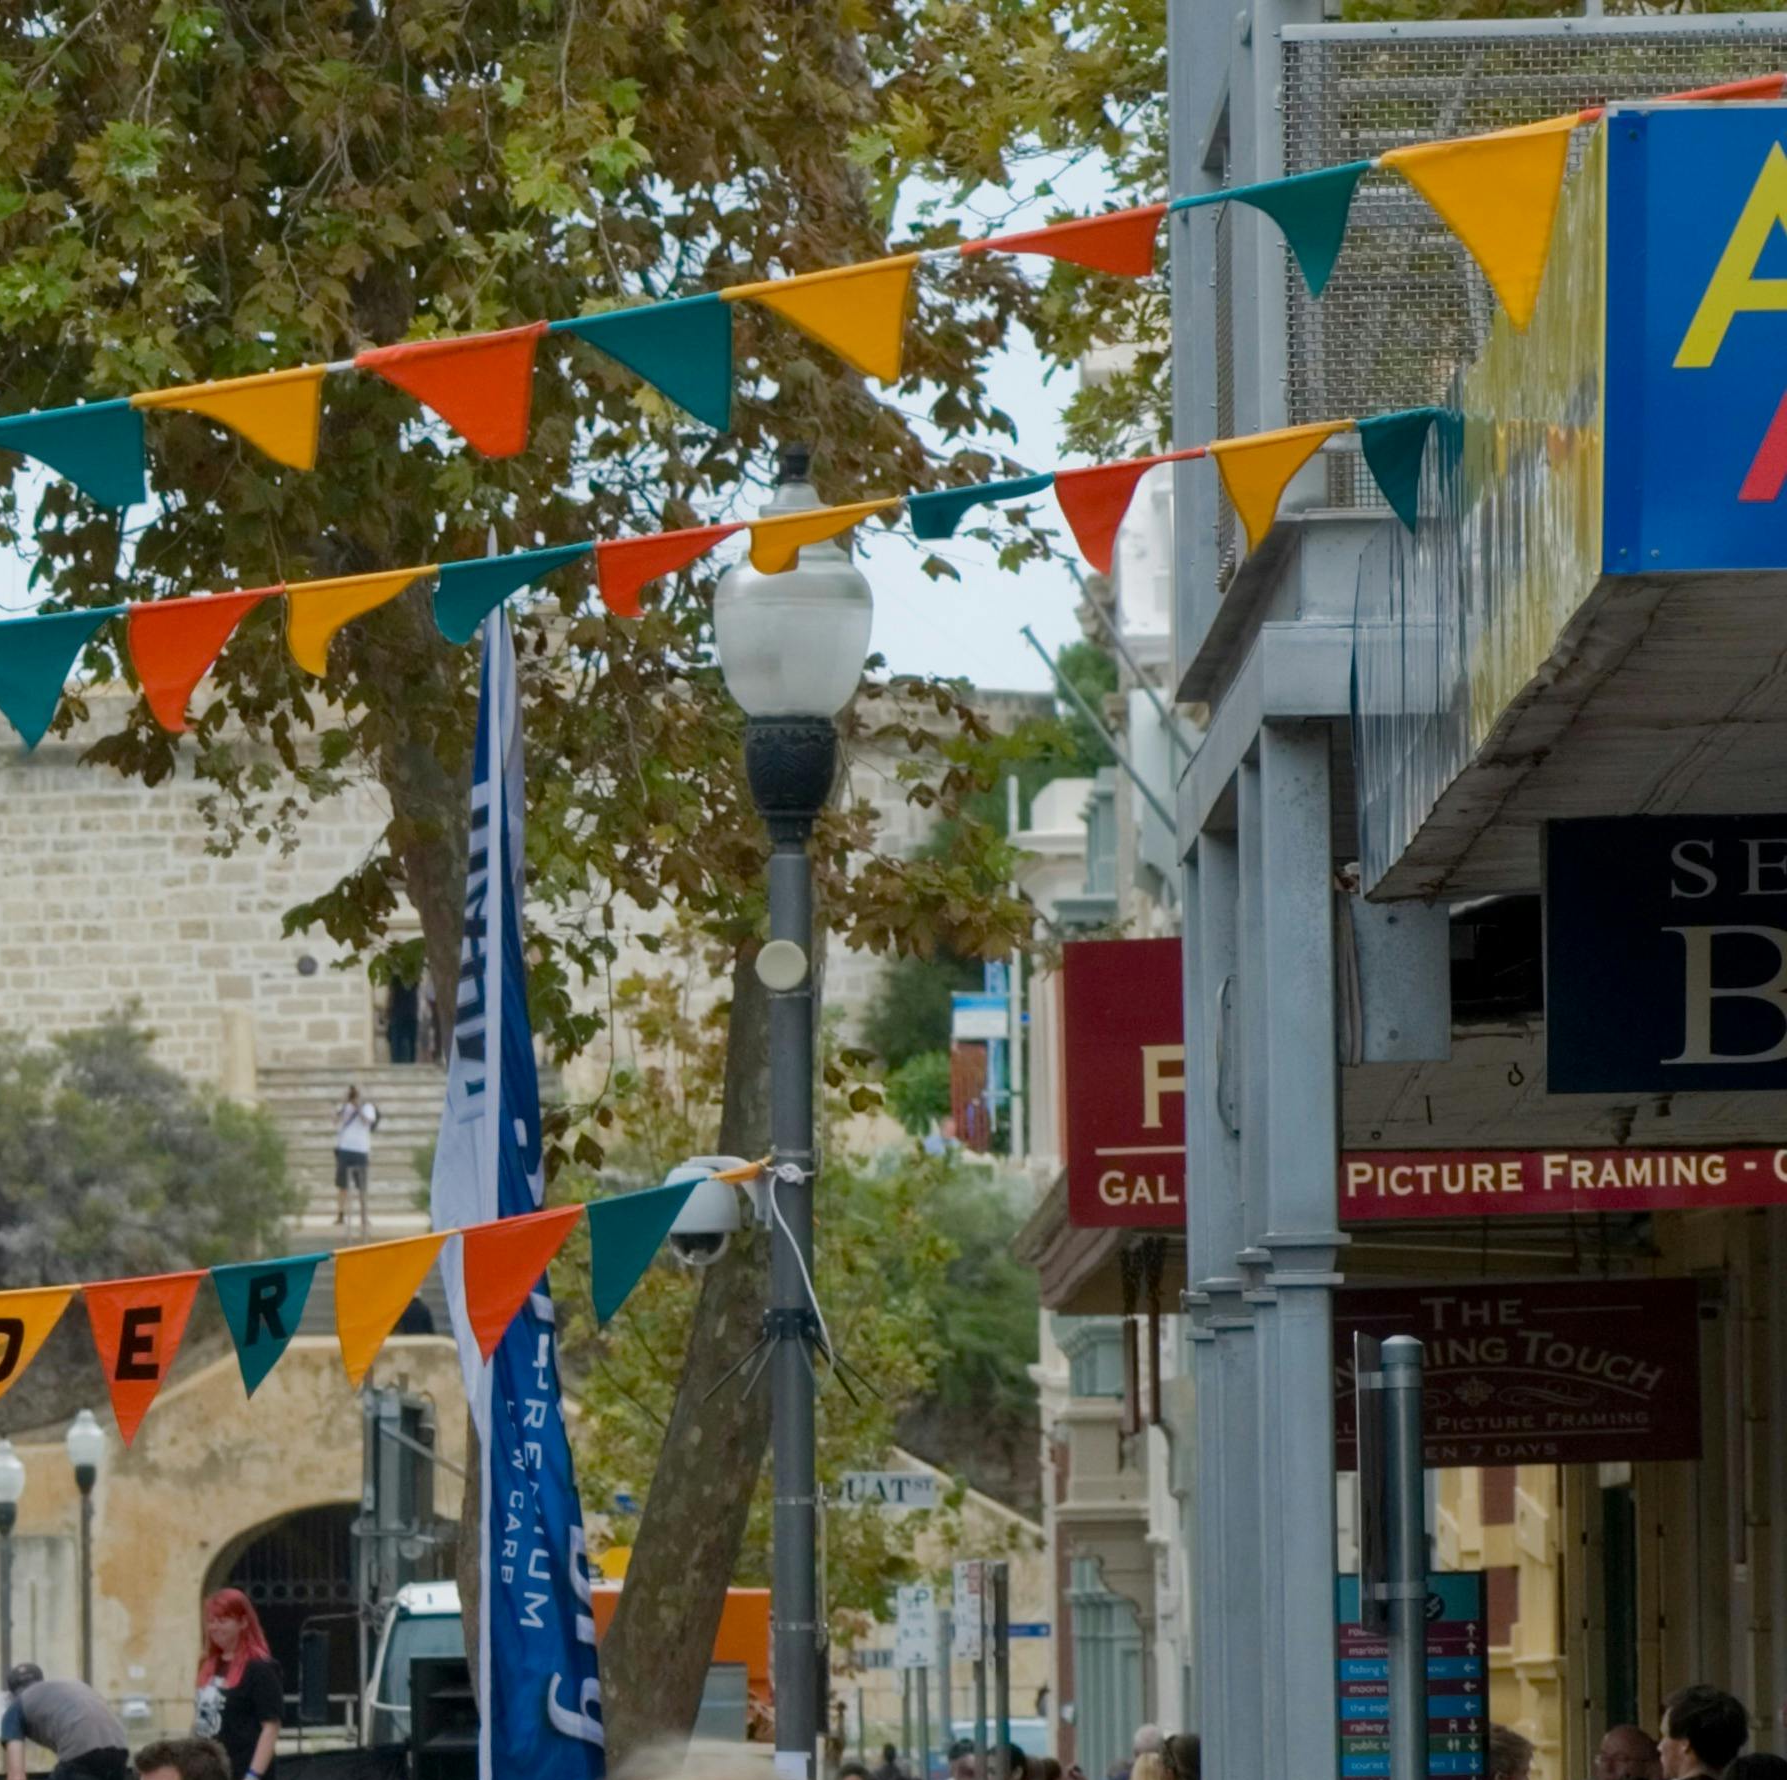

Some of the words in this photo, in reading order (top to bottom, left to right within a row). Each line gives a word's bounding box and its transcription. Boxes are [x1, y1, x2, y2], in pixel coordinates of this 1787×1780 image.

[1098, 1170, 1185, 1206] GAL
[1347, 1160, 1525, 1198] PICTURE
[1543, 1153, 1728, 1191] FRAMING
[1420, 1297, 1525, 1331] THE
[1516, 1330, 1666, 1392] TOUCH
[1435, 1415, 1535, 1432] PICTURE
[1546, 1410, 1650, 1428] FRAMING
[1470, 1444, 1485, 1458] 7
[1496, 1442, 1559, 1458] DAYS
[501, 1490, 525, 1585] CARB
[1350, 1739, 1379, 1751] public
